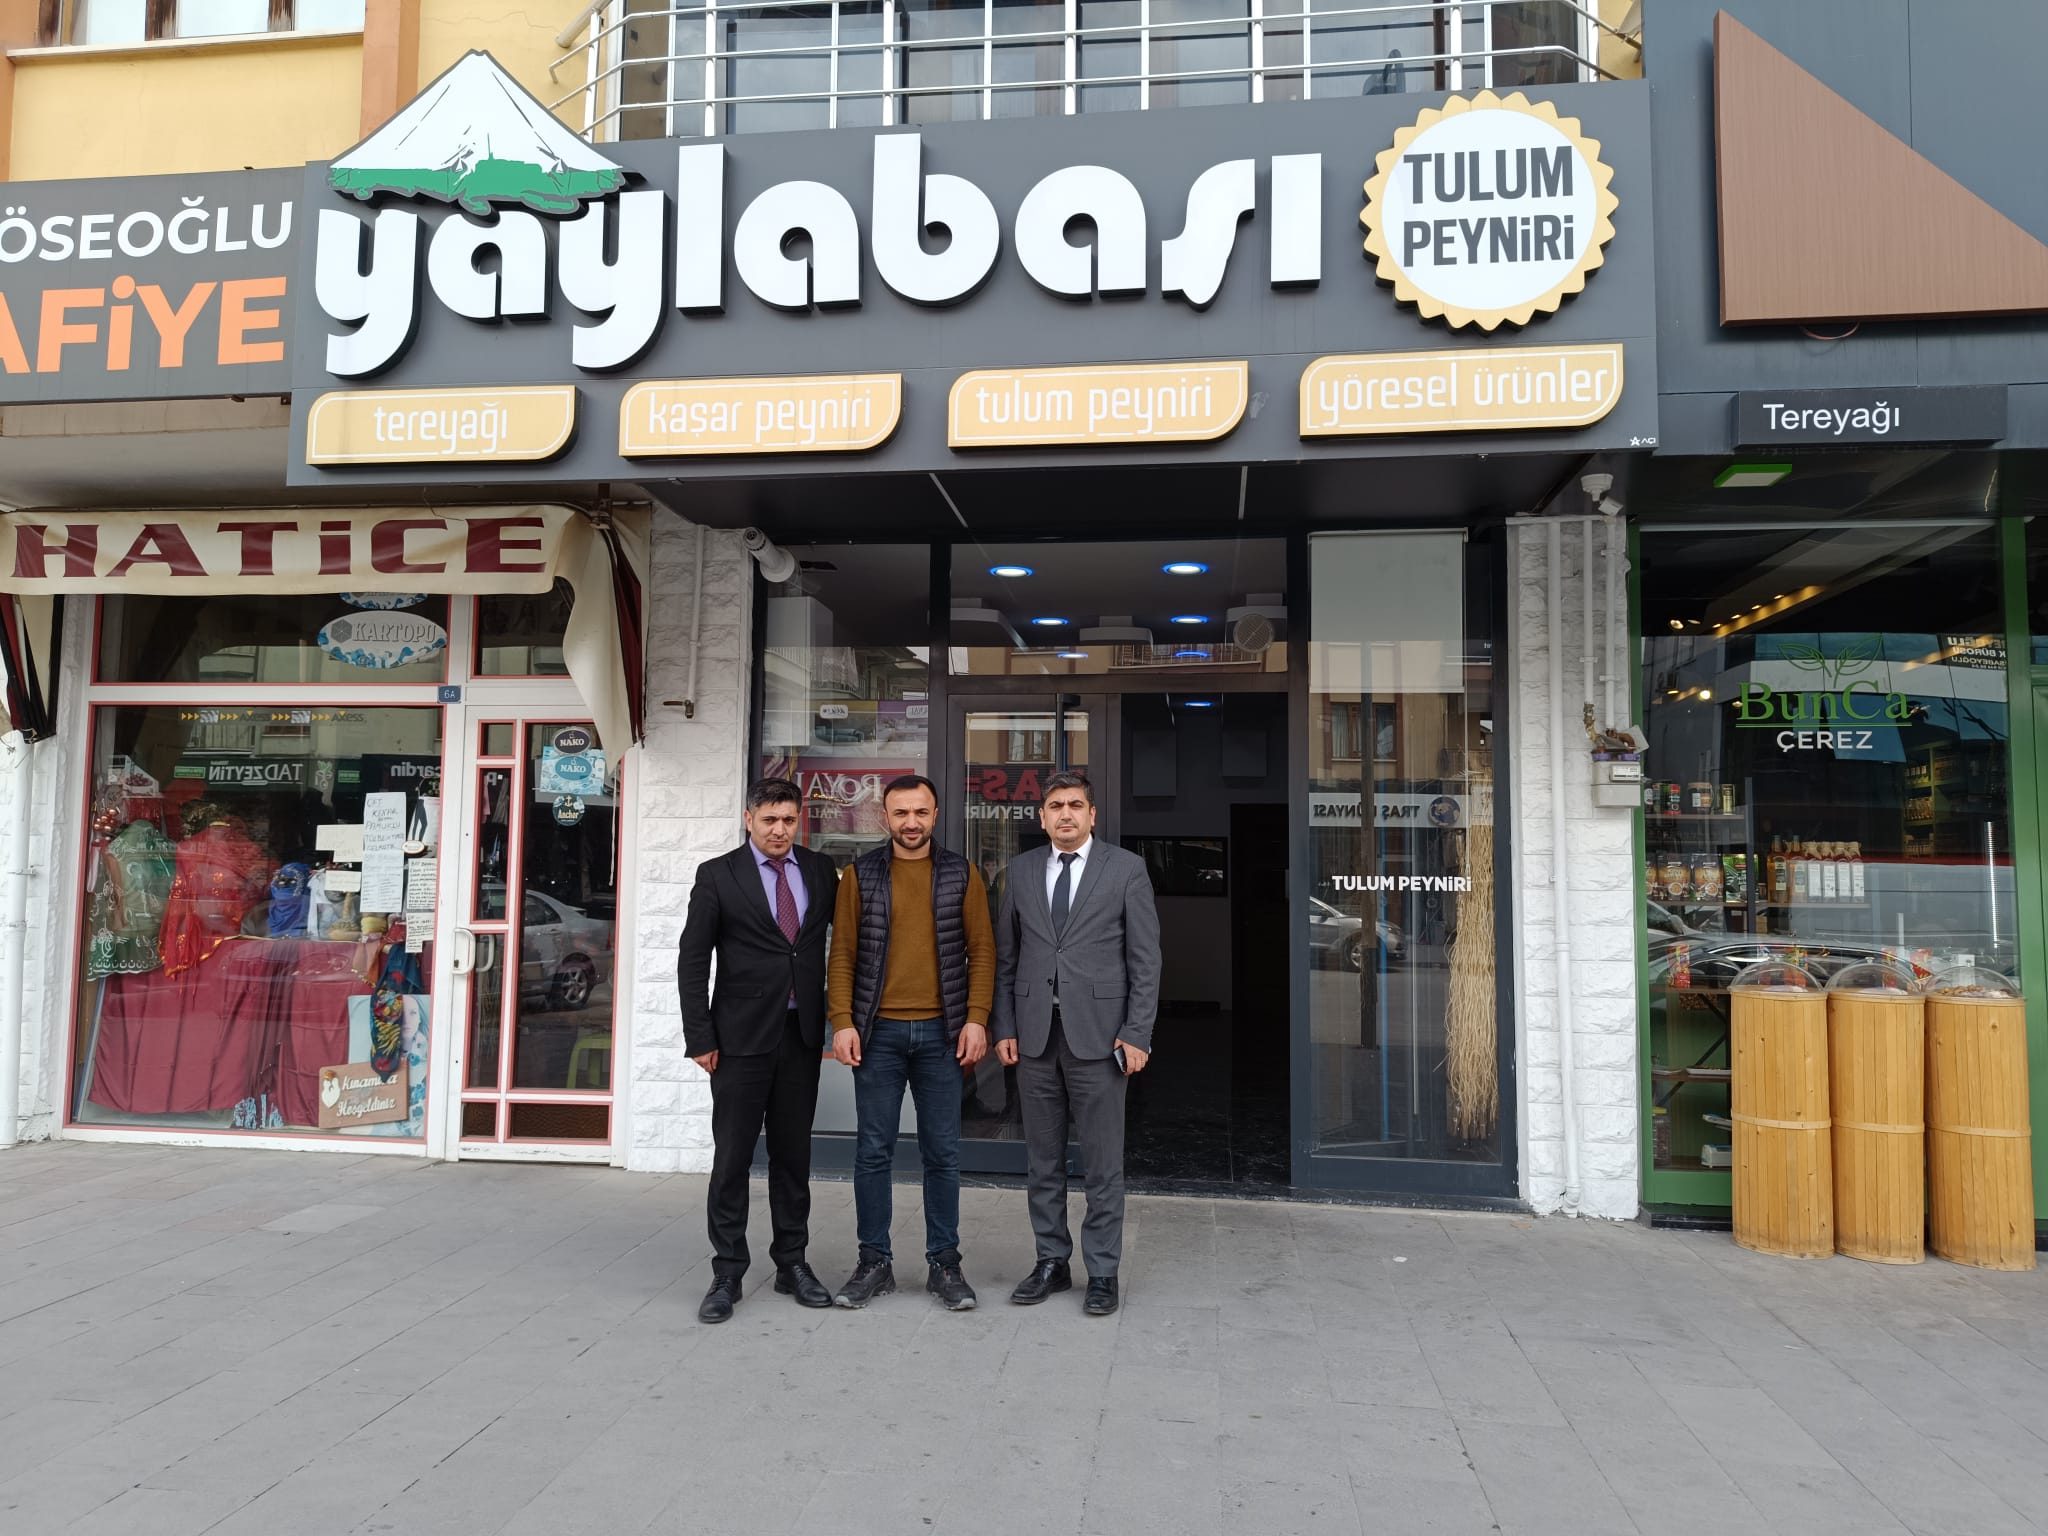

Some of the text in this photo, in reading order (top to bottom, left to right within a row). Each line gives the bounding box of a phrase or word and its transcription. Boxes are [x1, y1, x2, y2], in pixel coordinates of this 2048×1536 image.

[1403, 145, 1573, 204] TULUM
[976, 376, 1212, 434] tulum peyniri
[1319, 358, 1608, 427] yöresel ürünler
[374, 402, 508, 454] tereyağı
[649, 389, 871, 445] kaşar peyniri
[1762, 401, 1900, 436] Tereyağı
[353, 623, 437, 643] KARTOPU
[1736, 680, 1911, 721] BunCa
[560, 738, 585, 746] NAKO
[1776, 731, 1873, 752] ÇEREZ
[560, 765, 586, 773] NAKO
[1332, 875, 1395, 891] TULUM
